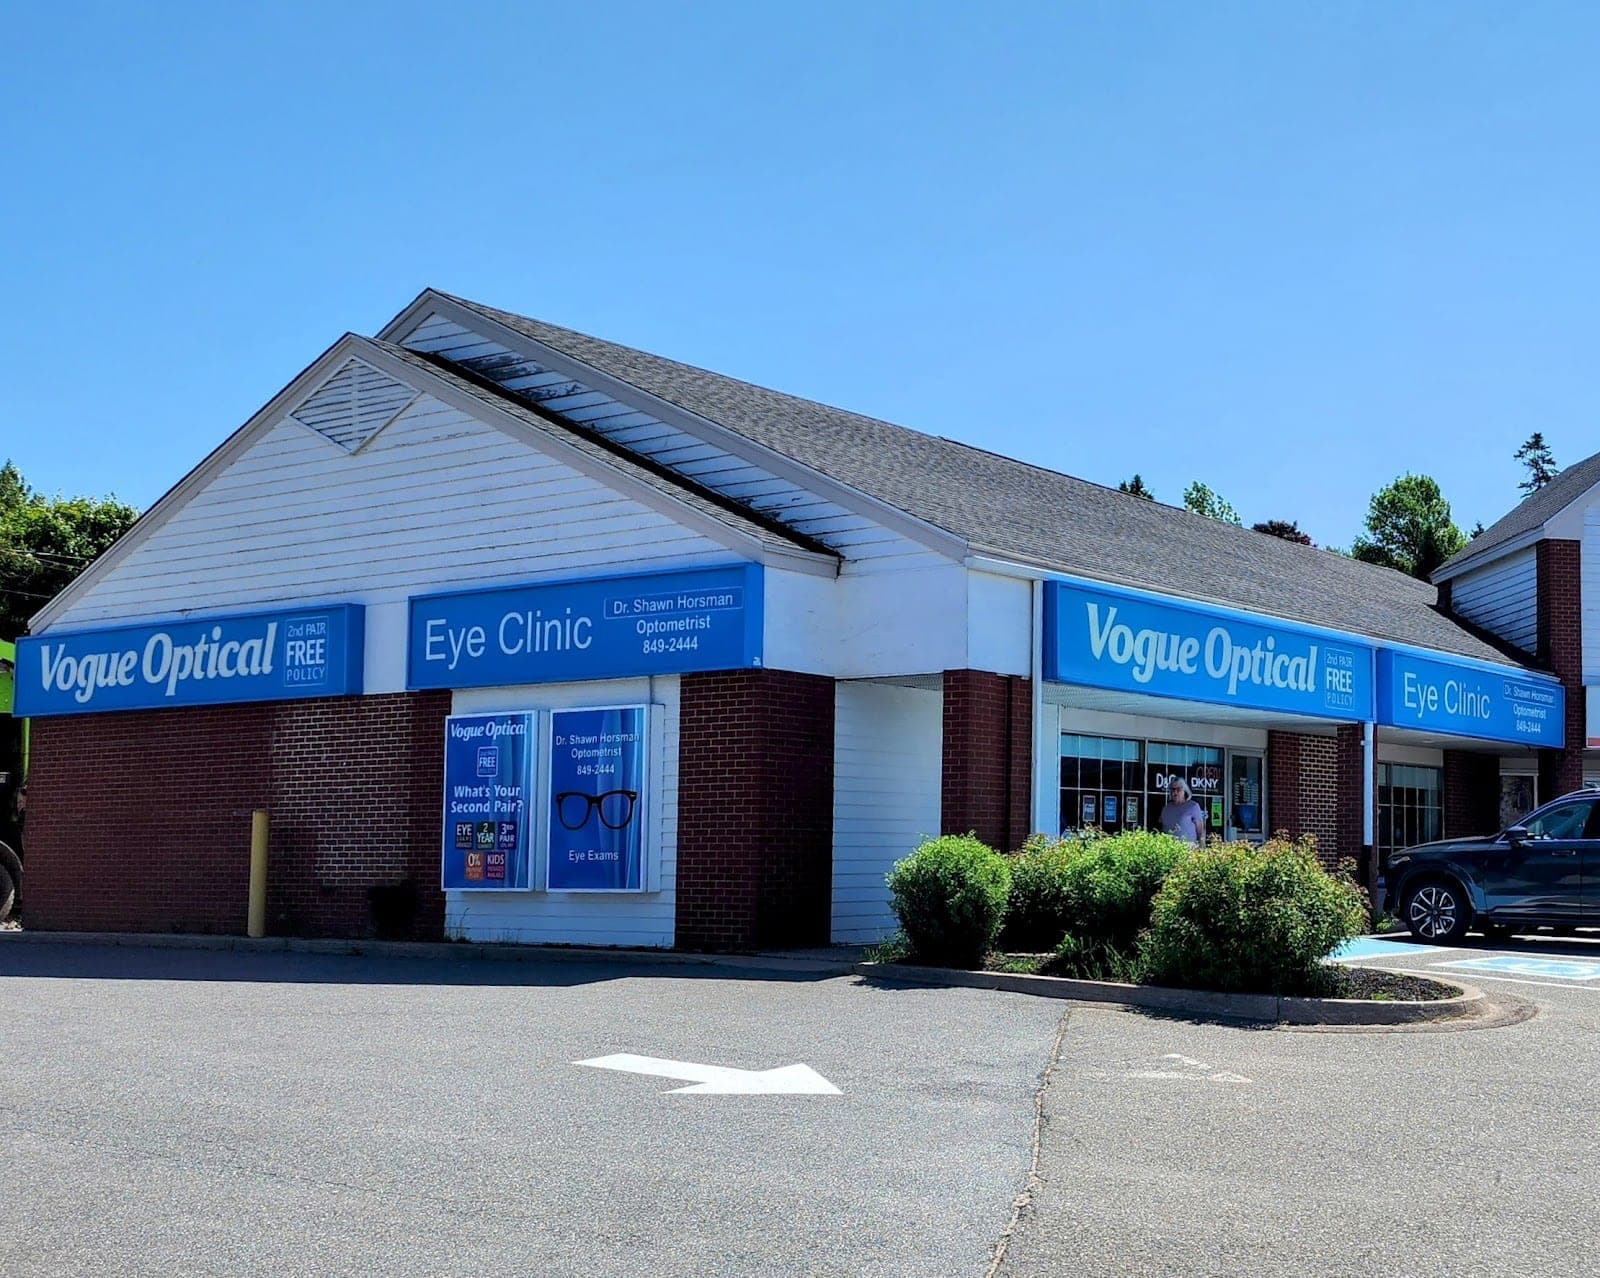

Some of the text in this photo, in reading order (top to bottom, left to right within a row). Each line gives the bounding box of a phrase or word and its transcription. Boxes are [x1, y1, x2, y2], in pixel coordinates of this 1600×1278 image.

[614, 594, 733, 614] Dr. Shawn Horsman
[288, 622, 326, 637] 2nd PAIR
[636, 615, 711, 636] Optometrist
[426, 607, 592, 670] Eye Clinic
[643, 635, 698, 654] 849-2444
[286, 639, 325, 666] FREE
[1086, 602, 1317, 695] Vogue Optical
[41, 622, 278, 703] Vogue Optical
[1339, 656, 1352, 667] PAIR
[287, 667, 325, 680] POLICY
[1326, 667, 1352, 693] FREE
[1327, 692, 1353, 705] POLICY
[1404, 672, 1490, 719] Eye Clinic
[451, 719, 528, 741] Vogue Optical
[556, 732, 640, 745] Dr. Shawn Horsman
[571, 747, 622, 760] Optometrist
[480, 756, 496, 767] FREE
[577, 764, 615, 775] 849-2444
[1191, 777, 1218, 788] DKNY
[454, 784, 521, 799] What's Your
[451, 799, 523, 813] Second Pair?
[456, 824, 472, 836] EYE
[482, 822, 489, 833] 2
[477, 832, 494, 843] YEAR
[499, 834, 515, 842] PAIR
[468, 852, 481, 867] 0%
[487, 854, 505, 865] KIDS
[569, 849, 619, 863] Eye Exams
